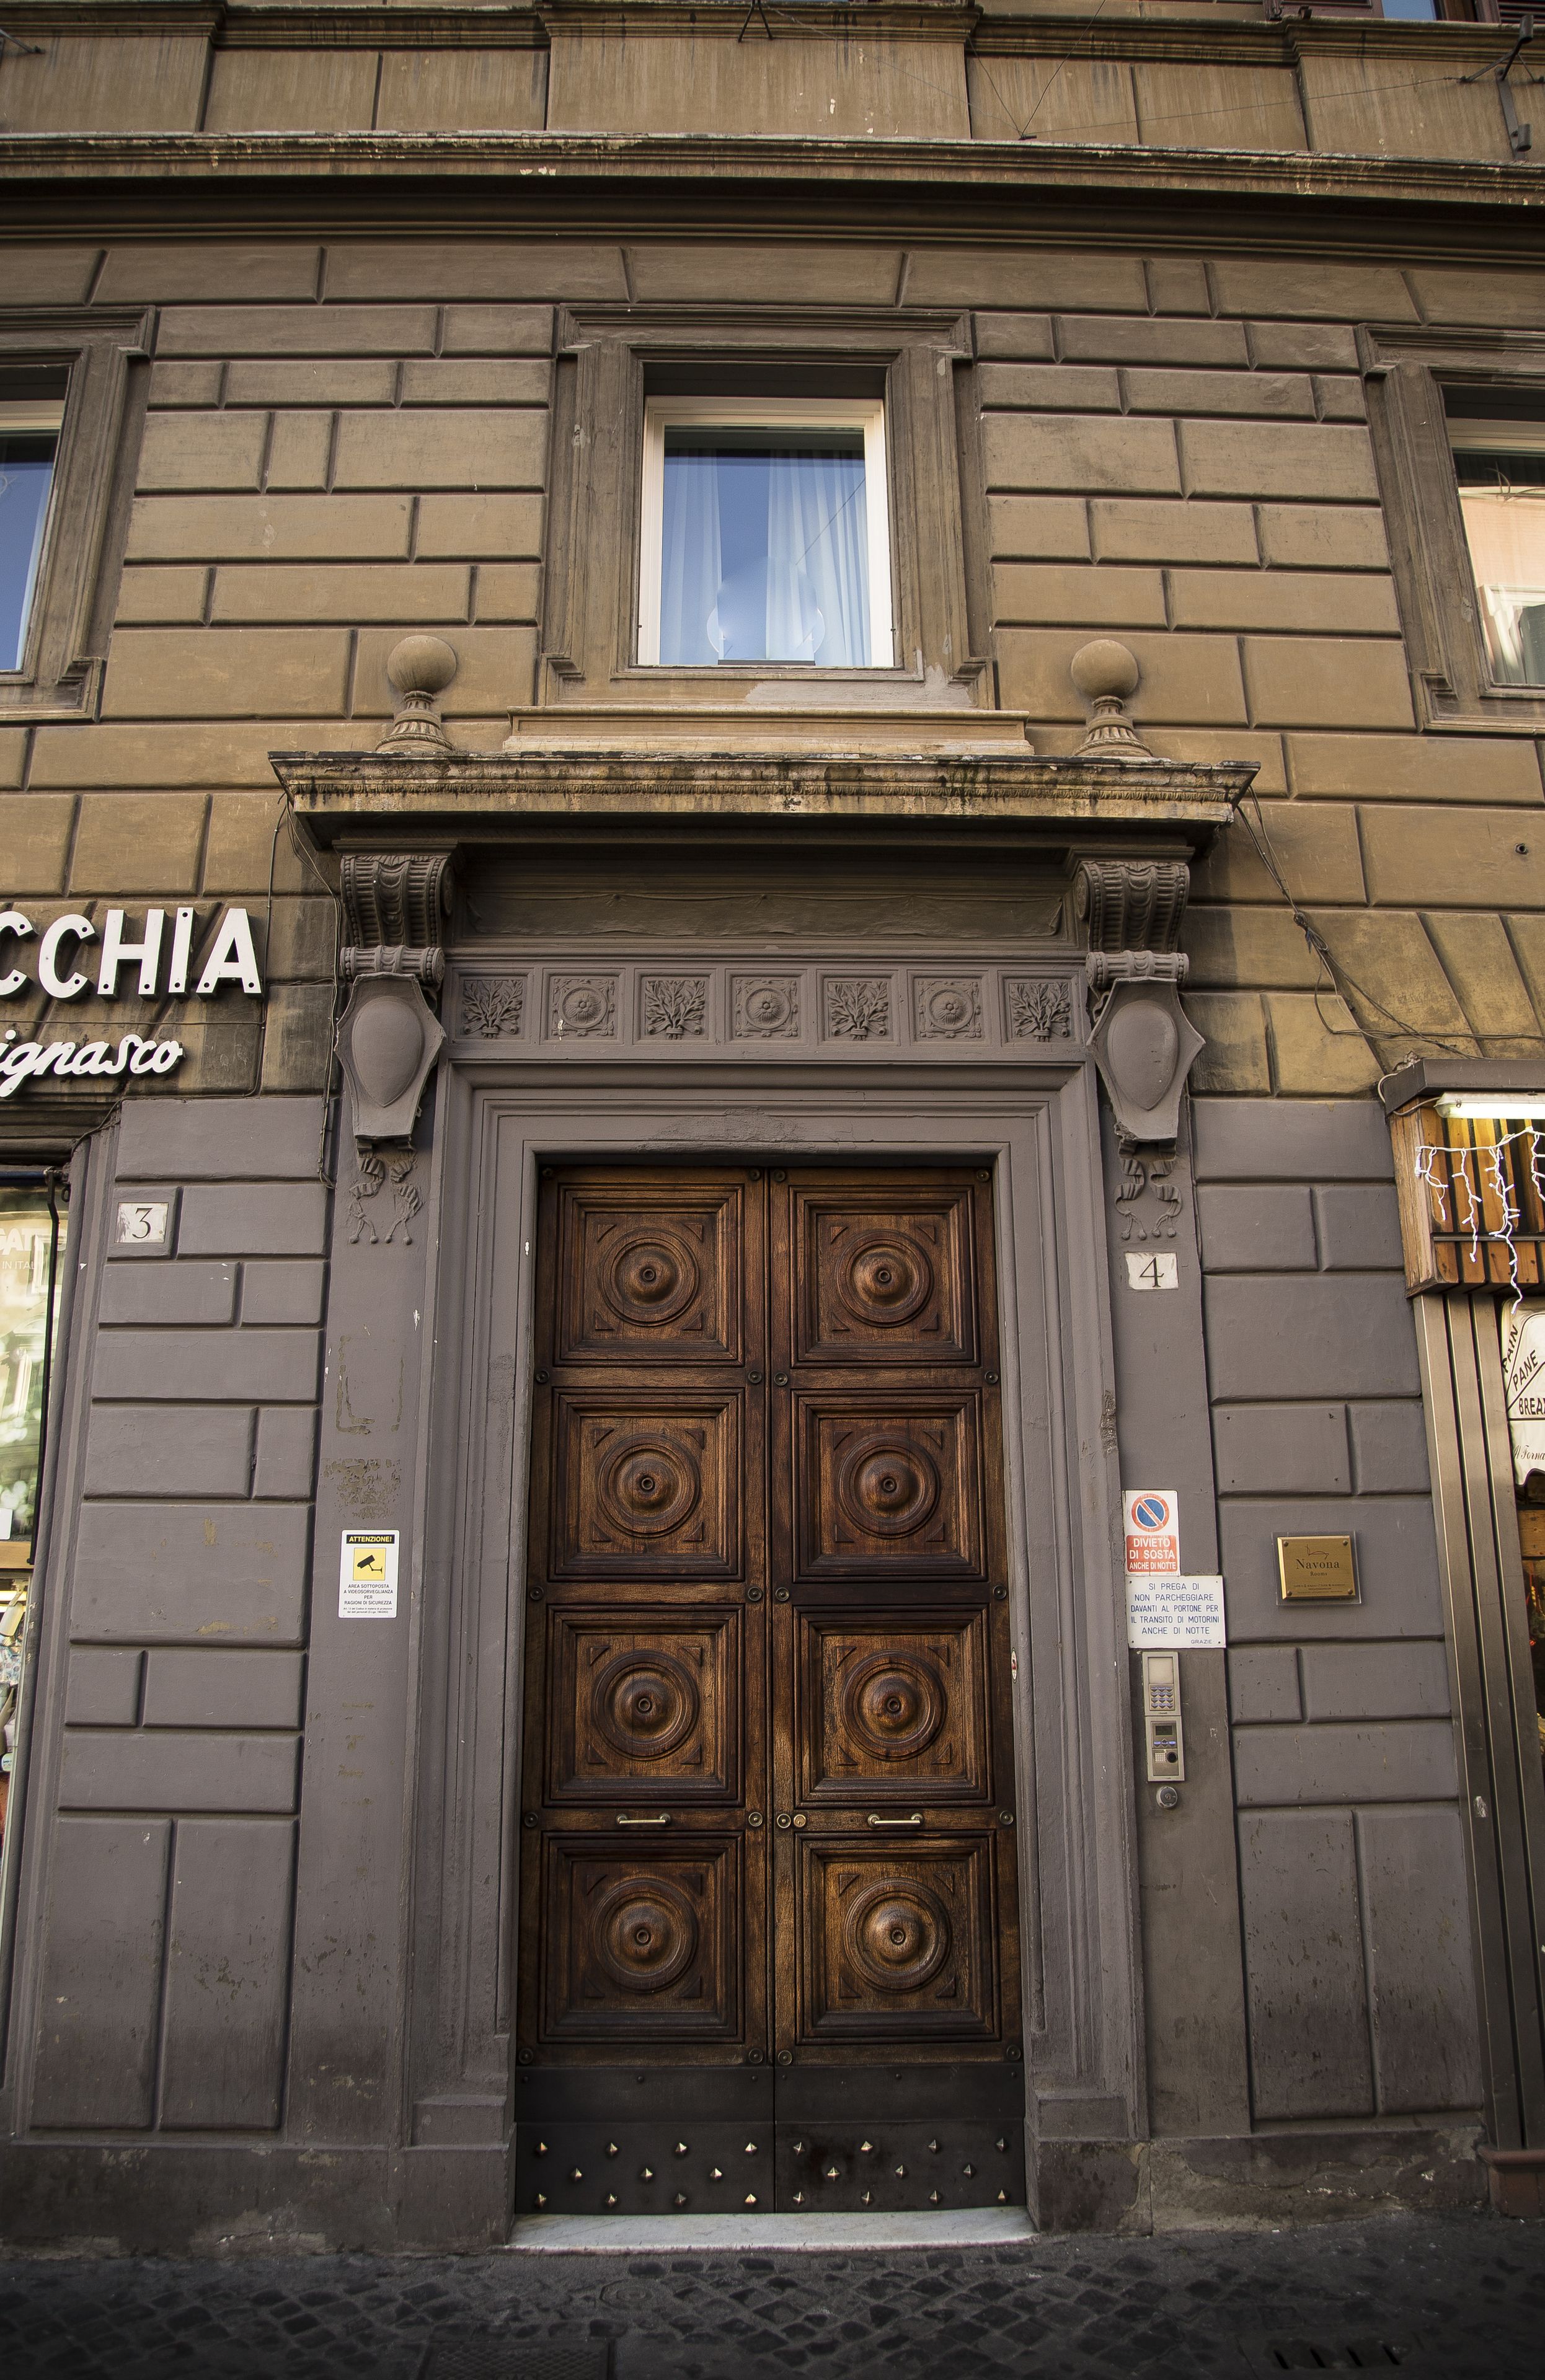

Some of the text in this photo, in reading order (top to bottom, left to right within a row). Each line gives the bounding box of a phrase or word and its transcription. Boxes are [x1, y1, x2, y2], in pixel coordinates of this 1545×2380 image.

[0, 907, 261, 998] CCHIA
[132, 1207, 153, 1238] 3
[1140, 1256, 1164, 1287] 4
[1502, 1324, 1518, 1373] PAIN
[1513, 1349, 1538, 1391] PANE
[1519, 1398, 1545, 1415] BREA
[1129, 1549, 1175, 1559] DI SOSTA
[1133, 1538, 1171, 1547] DIVIETO
[1296, 1558, 1340, 1569] Navona
